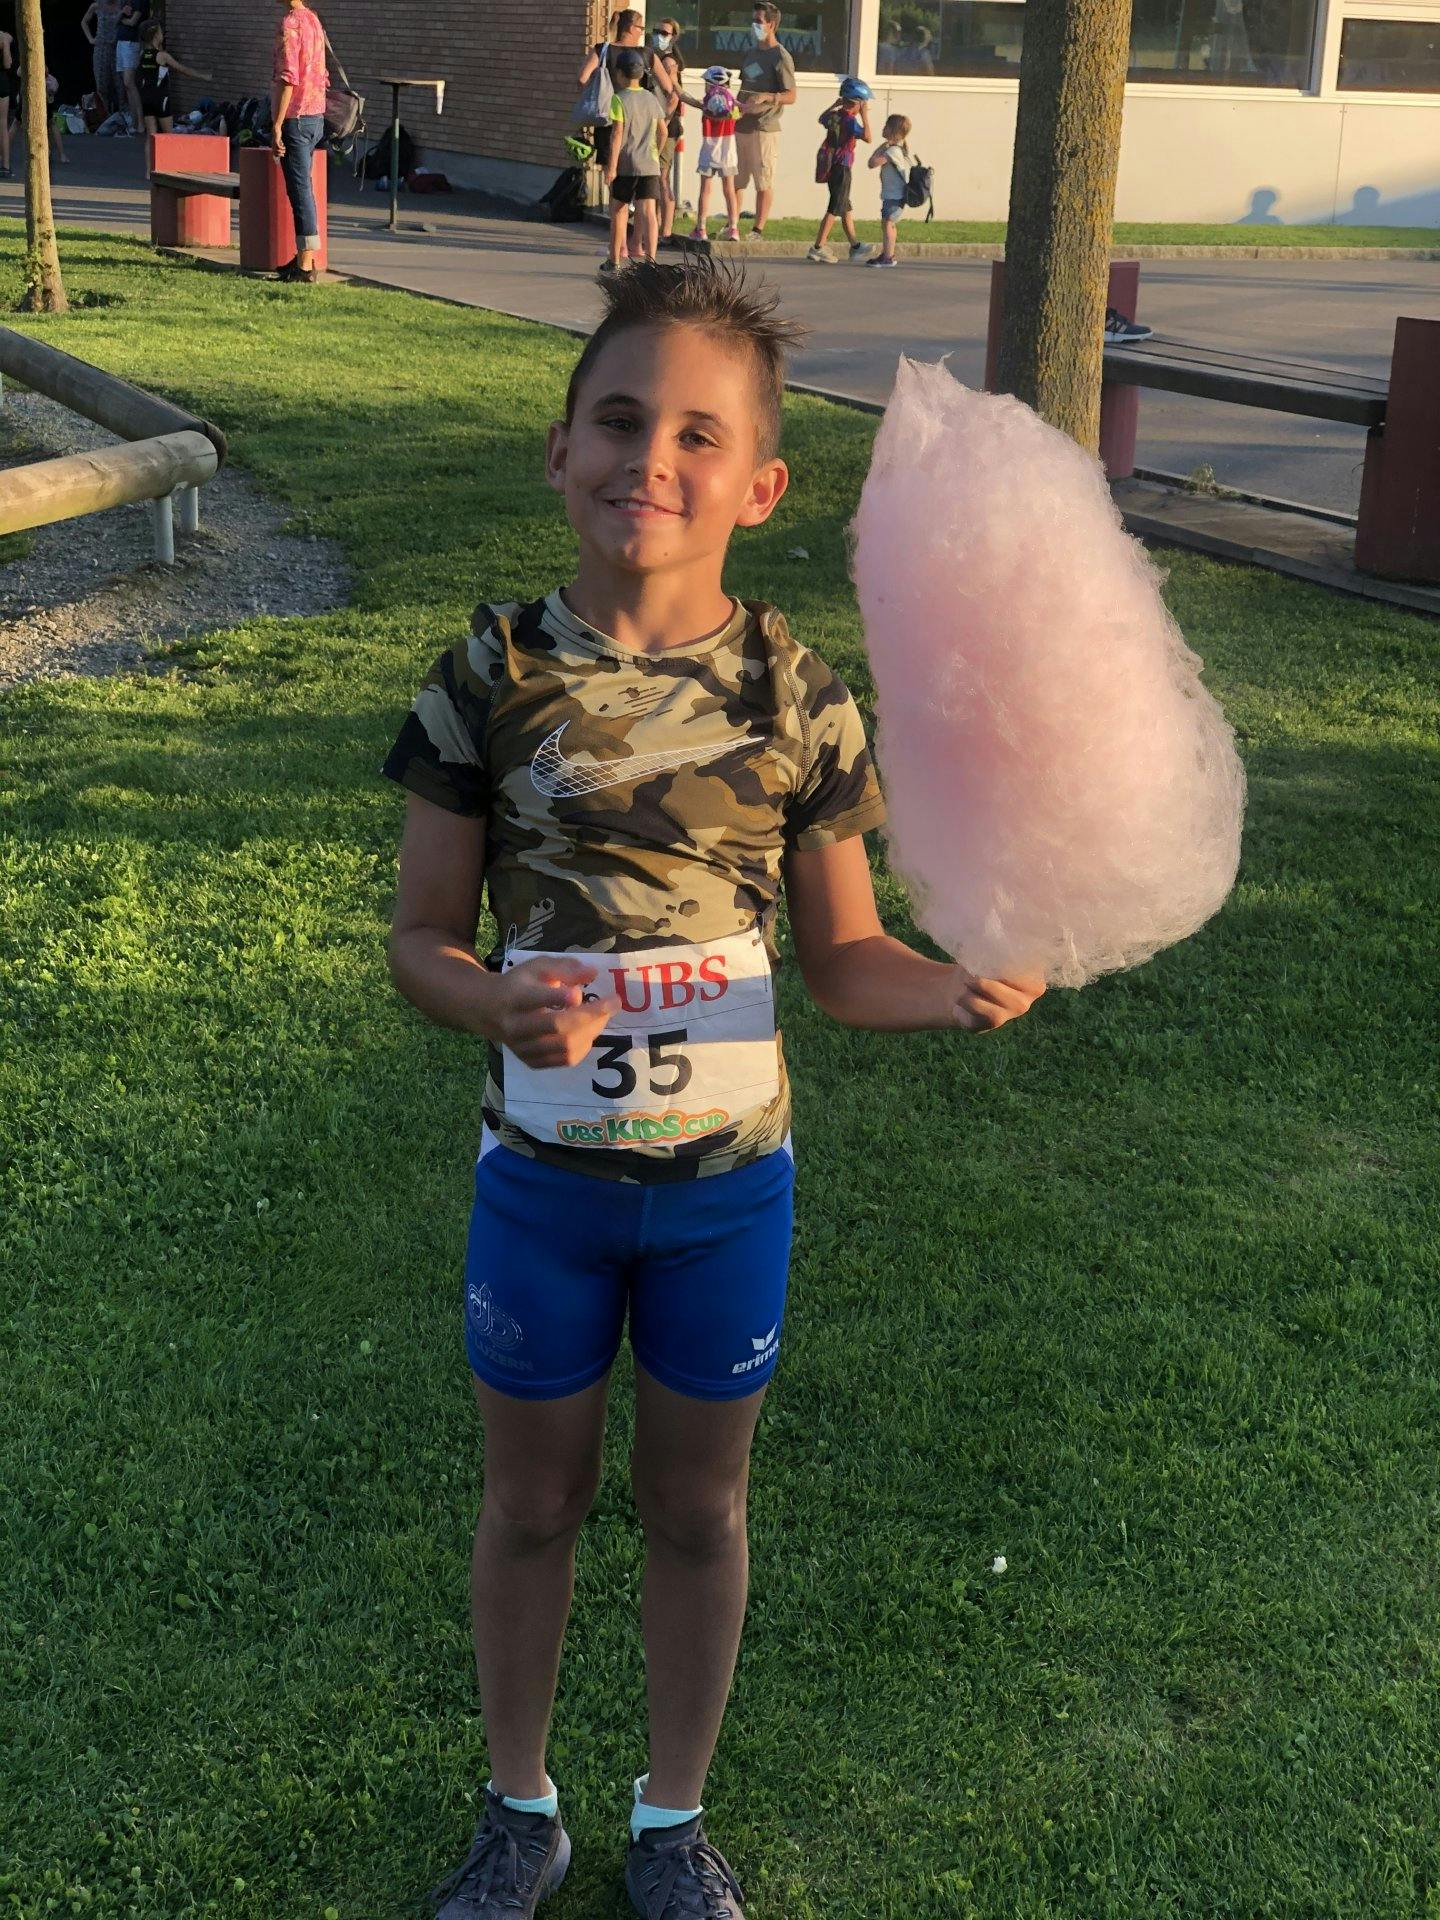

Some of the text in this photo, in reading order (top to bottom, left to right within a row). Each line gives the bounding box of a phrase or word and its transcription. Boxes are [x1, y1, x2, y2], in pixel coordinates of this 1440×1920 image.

[608, 955, 729, 1013] UBS
[592, 1029, 693, 1099] 35
[605, 1114, 683, 1143] KIDS
[684, 1113, 726, 1136] CUP
